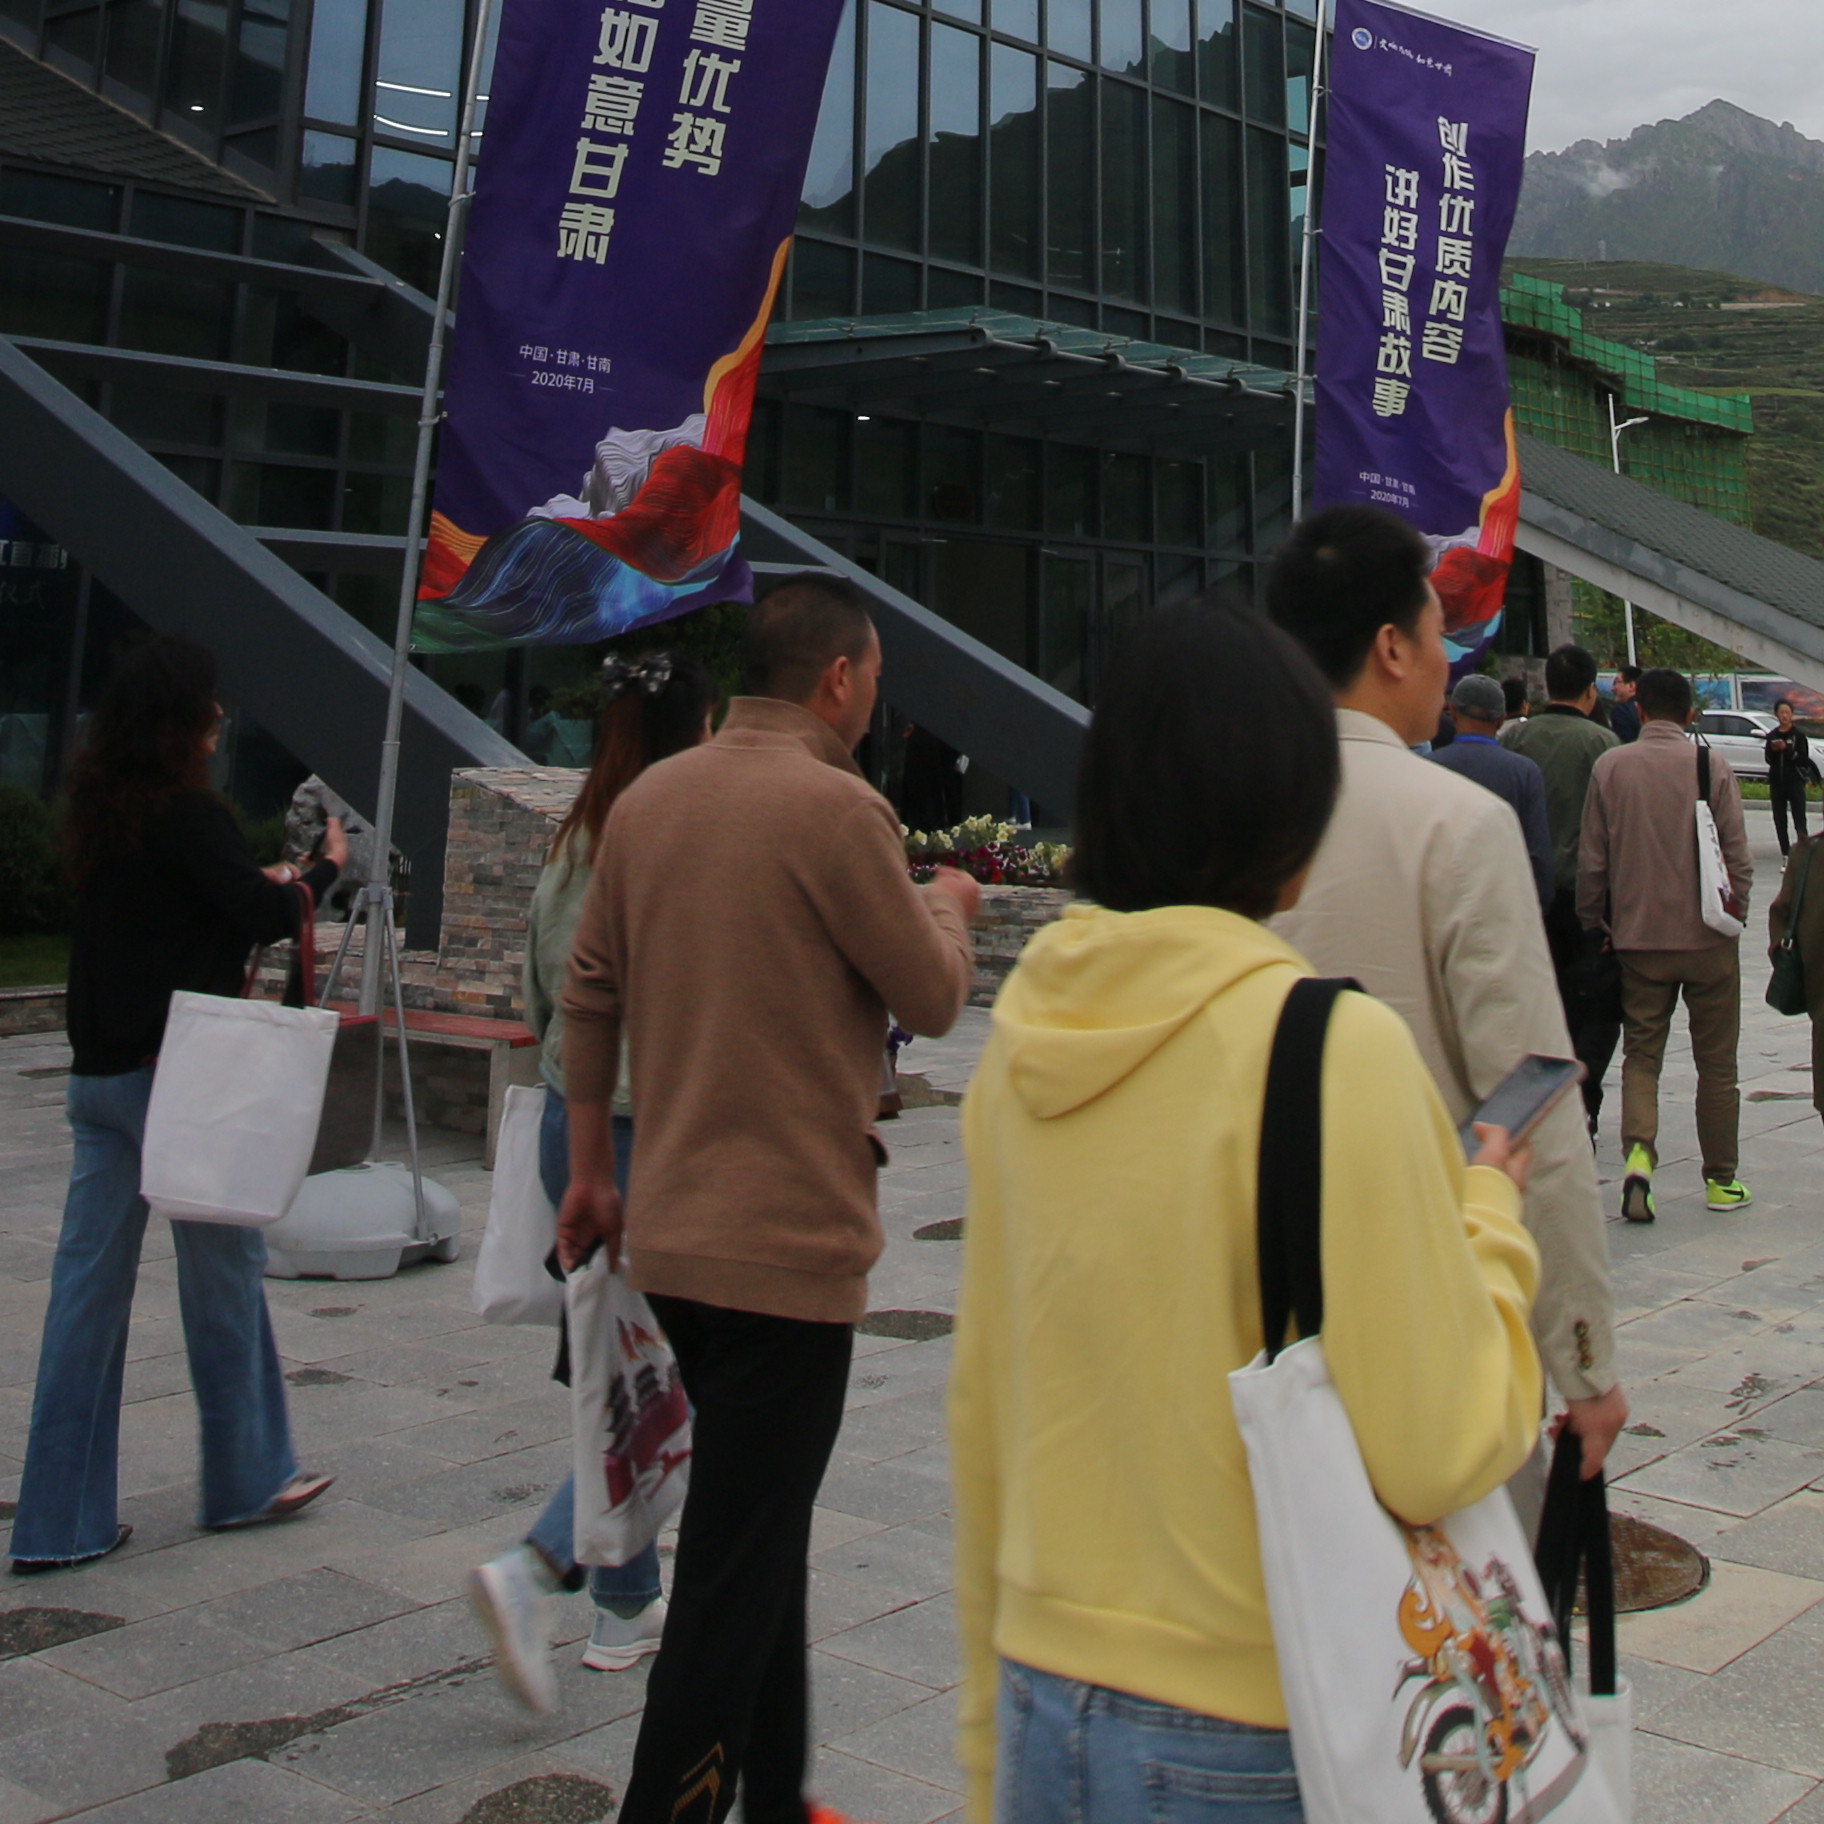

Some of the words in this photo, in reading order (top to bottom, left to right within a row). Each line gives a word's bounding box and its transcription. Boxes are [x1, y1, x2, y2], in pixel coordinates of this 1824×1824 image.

[1371, 163, 1420, 418] 讲好甘肃故事
[1421, 114, 1475, 365] 创作优质内容
[531, 370, 594, 394] 2020年7月
